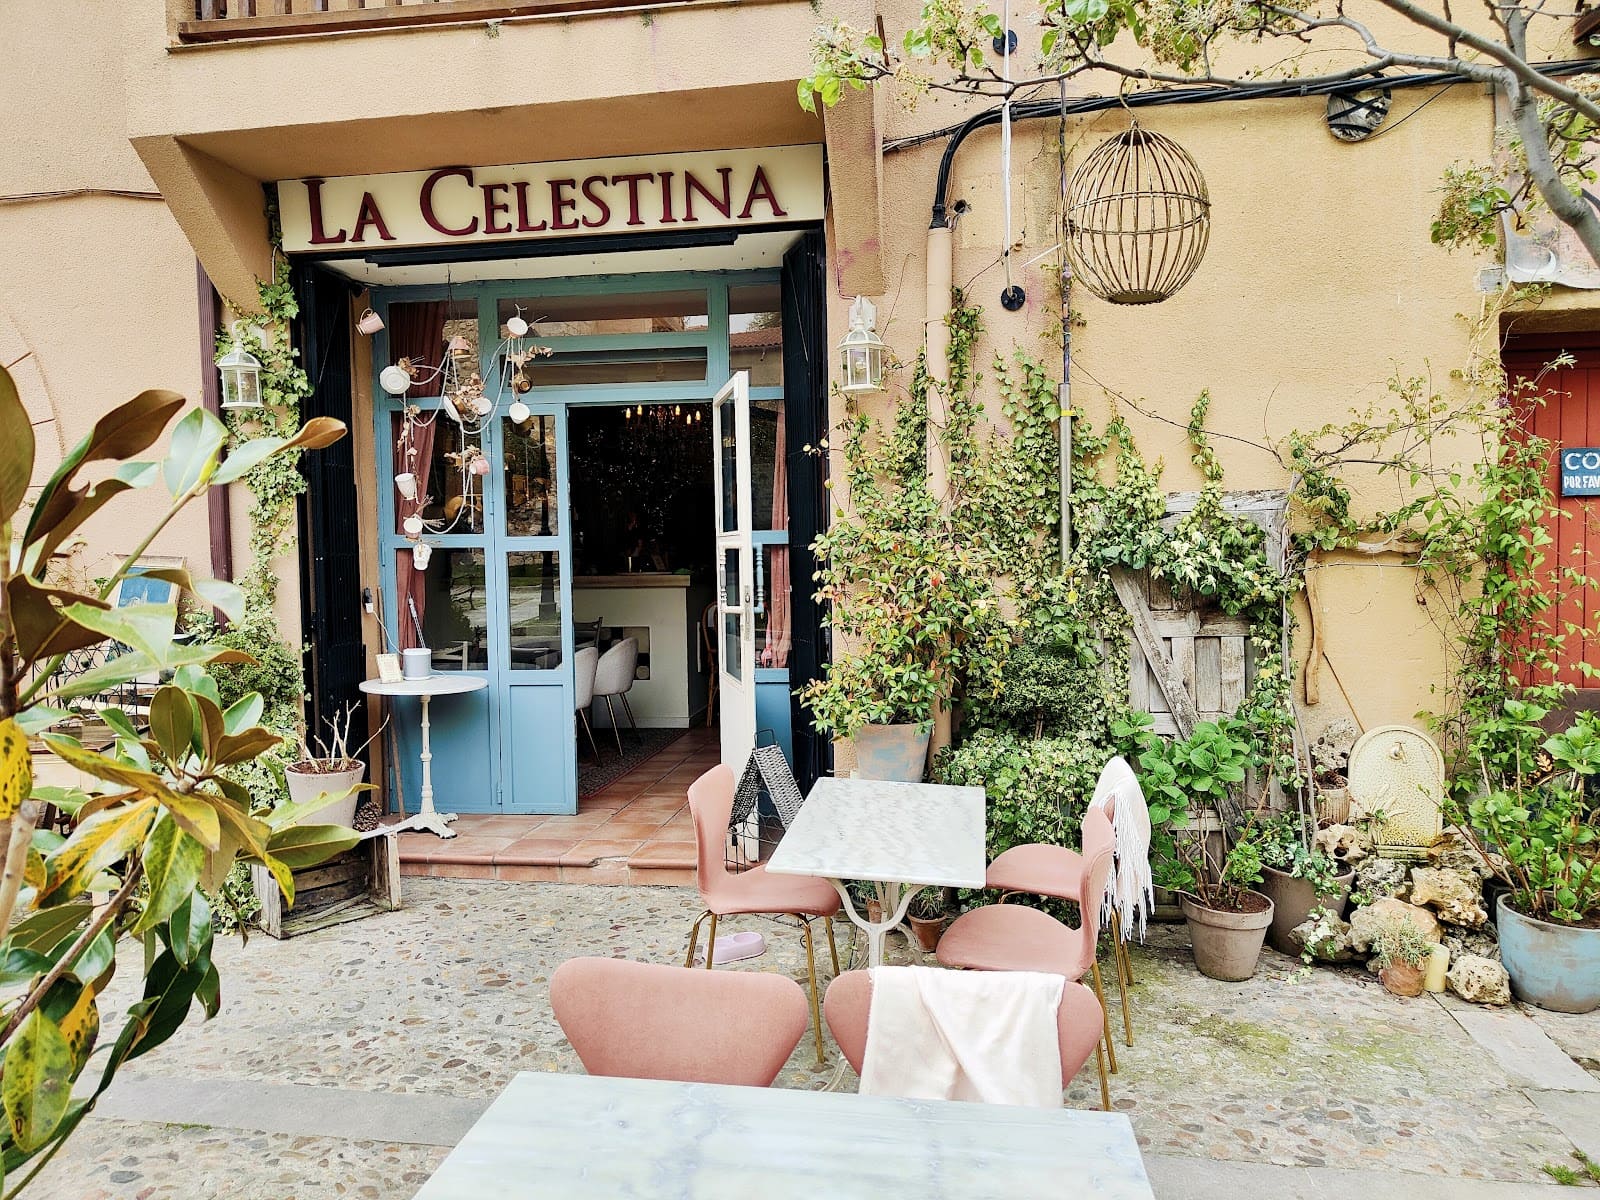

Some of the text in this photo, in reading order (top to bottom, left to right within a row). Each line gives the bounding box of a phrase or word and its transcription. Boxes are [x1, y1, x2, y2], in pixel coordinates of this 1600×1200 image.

[301, 165, 788, 245] LA CELESTINA
[1563, 475, 1581, 489] POR
